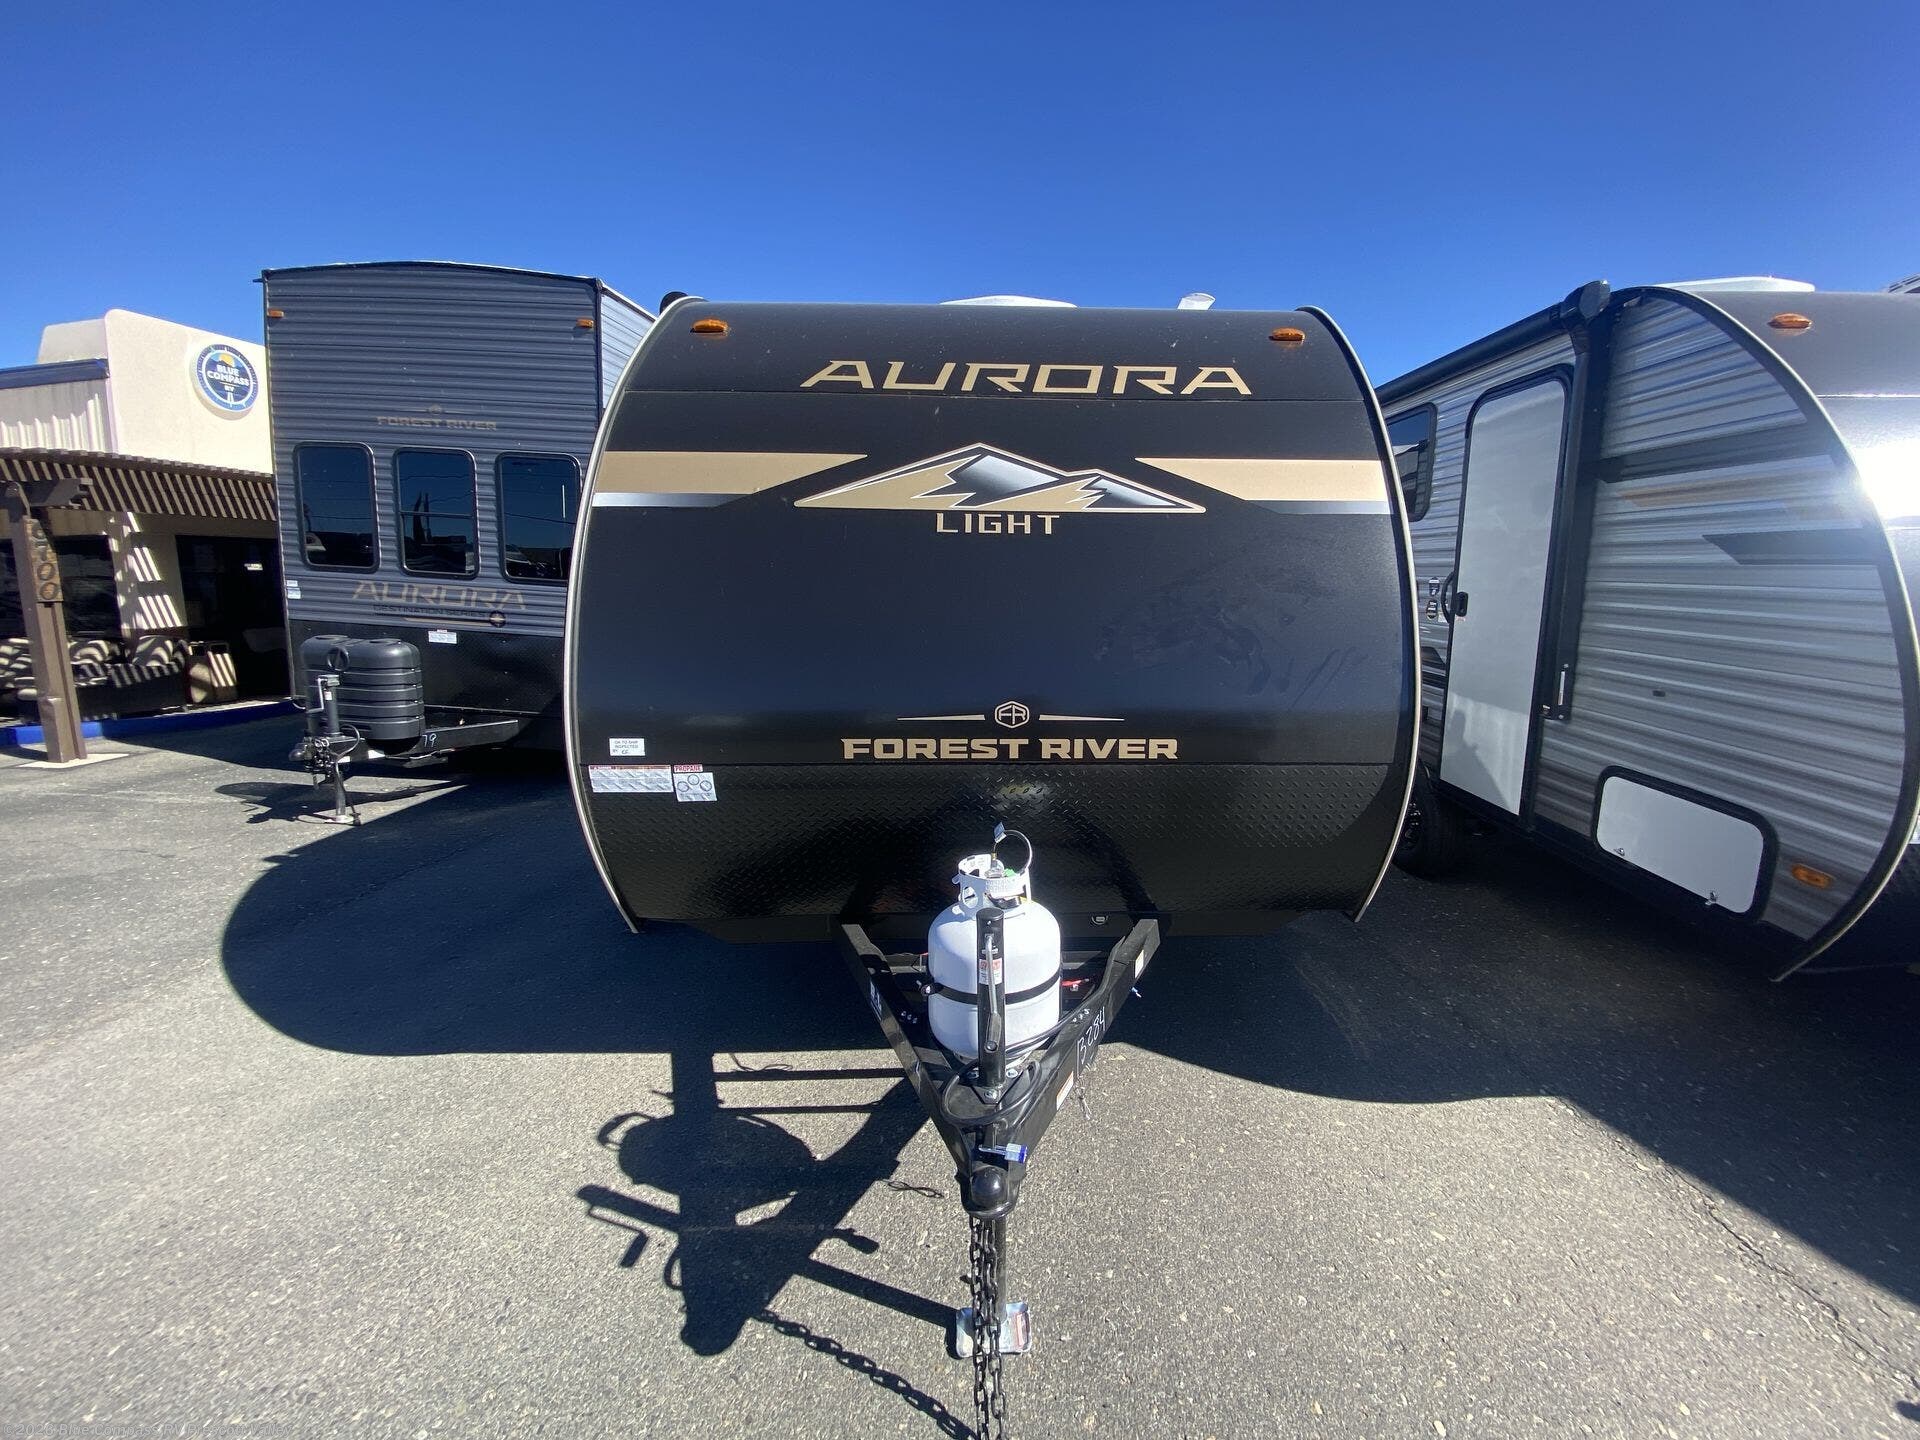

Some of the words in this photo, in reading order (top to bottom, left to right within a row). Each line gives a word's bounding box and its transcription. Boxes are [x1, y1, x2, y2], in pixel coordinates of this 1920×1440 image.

[207, 371, 250, 387] COMPASS
[216, 364, 240, 377] BLUE
[800, 360, 1252, 396] AURORA
[936, 513, 1060, 535] LIGHT
[352, 580, 527, 610] AURORA
[841, 738, 1029, 760] FOREST
[1038, 738, 1178, 760] RIVER
